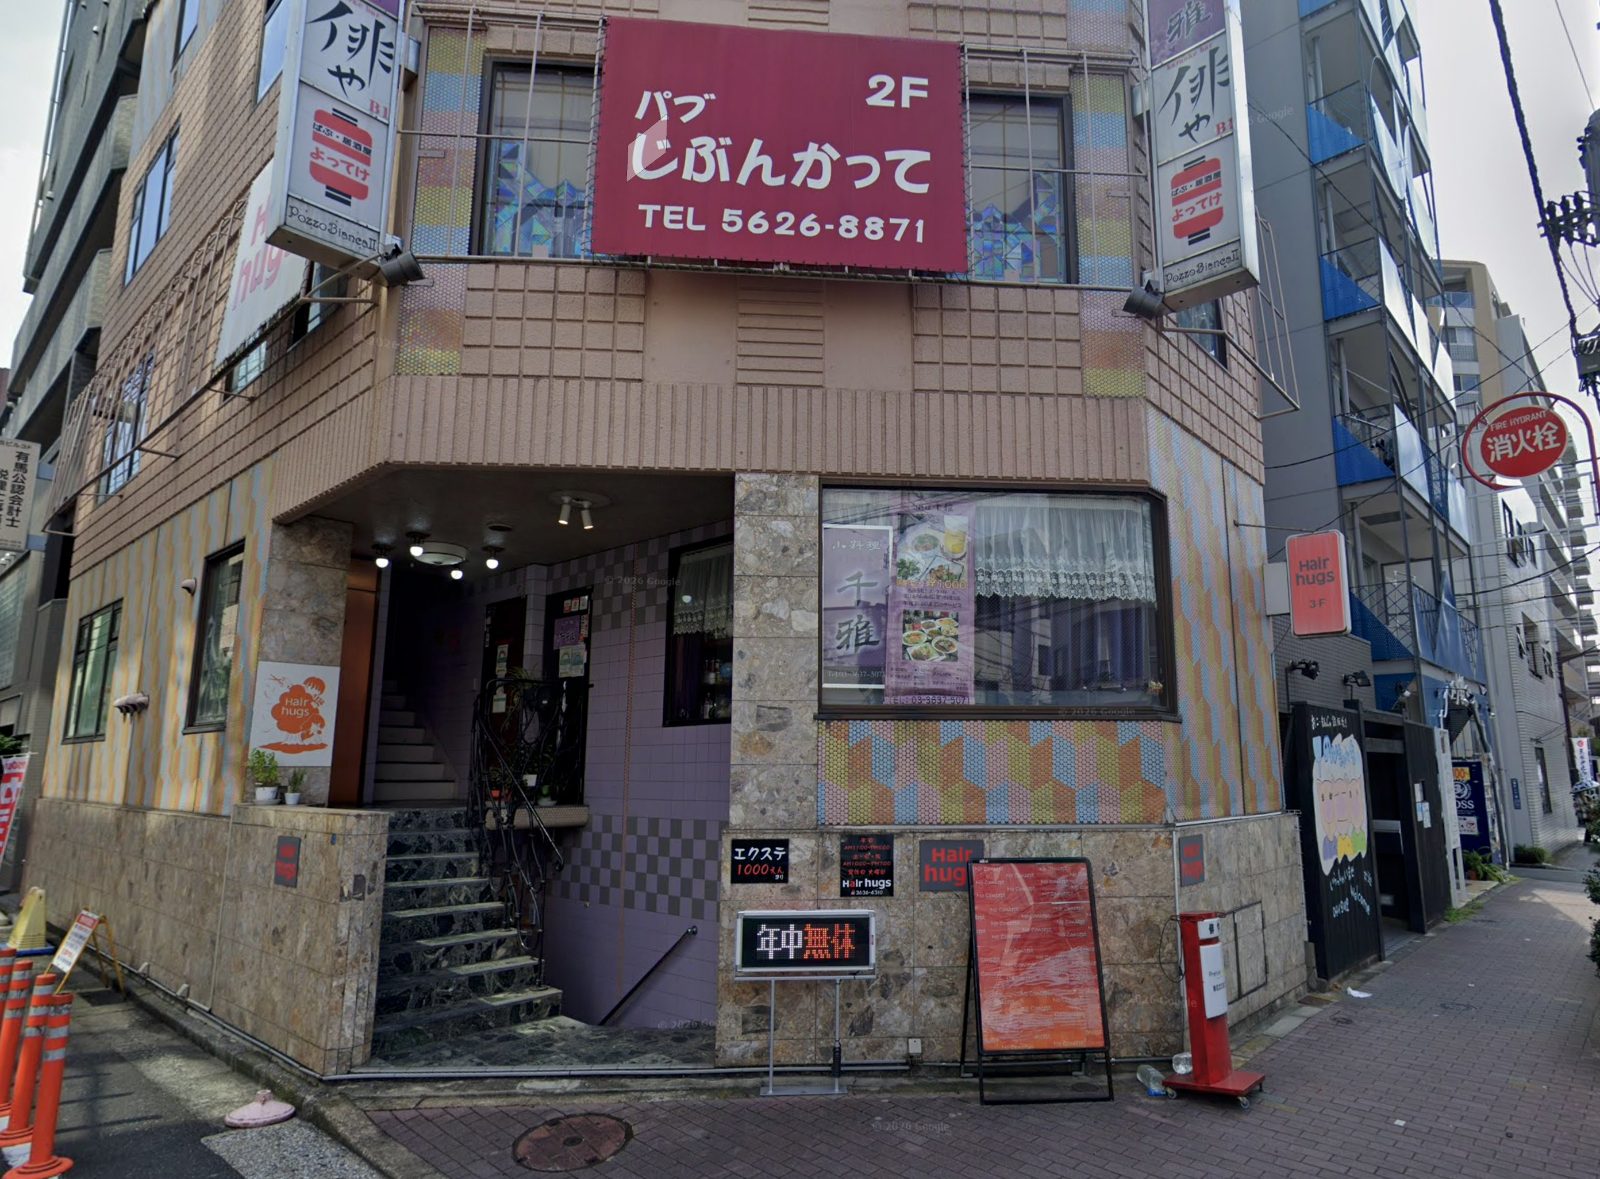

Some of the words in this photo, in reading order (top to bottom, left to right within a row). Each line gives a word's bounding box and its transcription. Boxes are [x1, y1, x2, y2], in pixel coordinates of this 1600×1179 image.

[865, 74, 929, 108] 2F
[634, 91, 716, 123] パブ
[310, 146, 370, 182] よってけ
[632, 133, 932, 194] じぶんかって
[1172, 192, 1223, 222] よってけ
[638, 204, 706, 231] TEL
[722, 209, 924, 243] 5626-8871
[232, 244, 290, 311] hug
[1490, 420, 1508, 431] FIRE
[1510, 410, 1548, 427] HYDRANT
[1486, 421, 1561, 463] 消火栓
[1298, 556, 1330, 572] Hair
[1295, 571, 1335, 586] hugs
[281, 706, 310, 718] hugs
[285, 696, 309, 706] Hair
[1455, 799, 1475, 810] OSS
[734, 847, 786, 861] エクステ
[931, 847, 973, 864] Hair
[842, 879, 863, 888] Hair
[864, 878, 892, 890] hugs
[924, 864, 968, 887] hug
[756, 923, 856, 959] 年中無休
